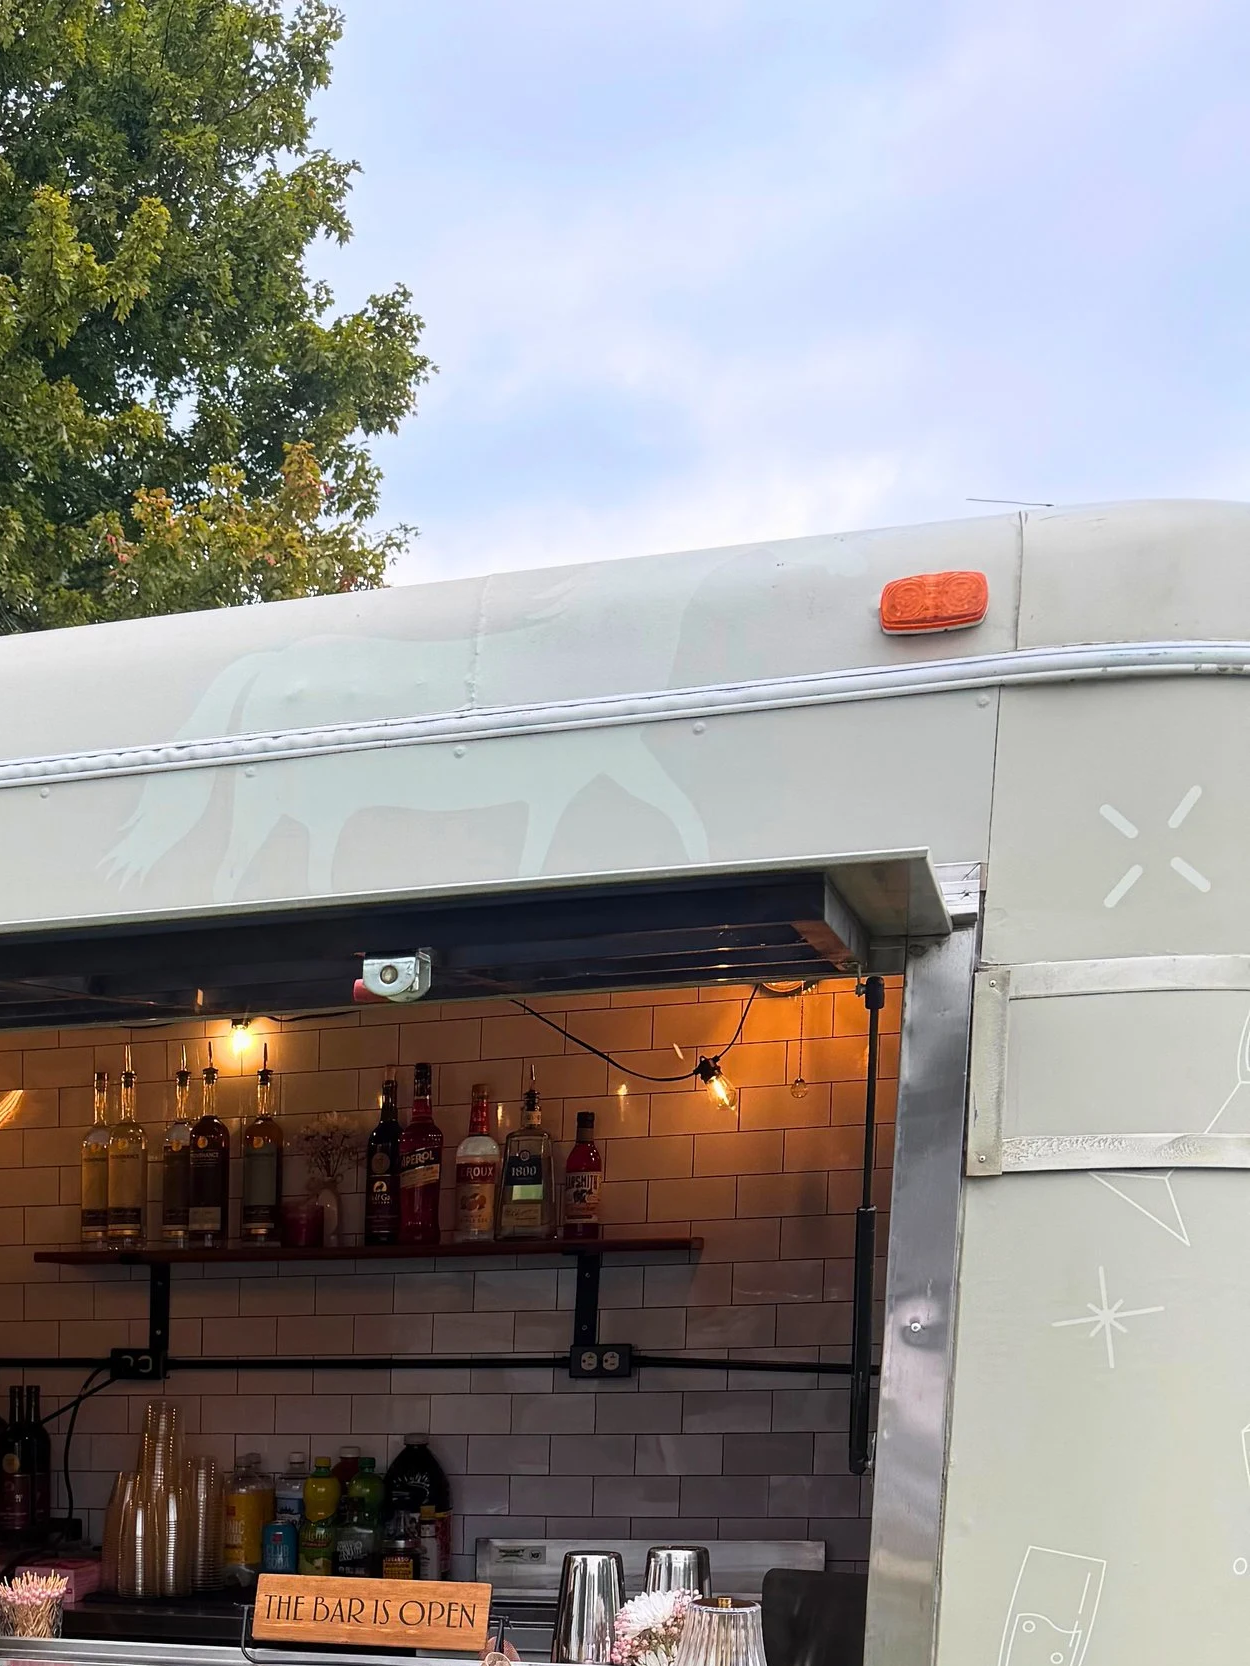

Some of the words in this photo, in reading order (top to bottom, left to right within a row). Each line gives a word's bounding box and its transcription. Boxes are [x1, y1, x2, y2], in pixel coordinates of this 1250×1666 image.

[511, 1165, 538, 1177] 1800
[264, 1594, 305, 1621] THE
[312, 1596, 365, 1625] BAR
[372, 1598, 392, 1625] IS
[399, 1600, 476, 1629] OPEN
